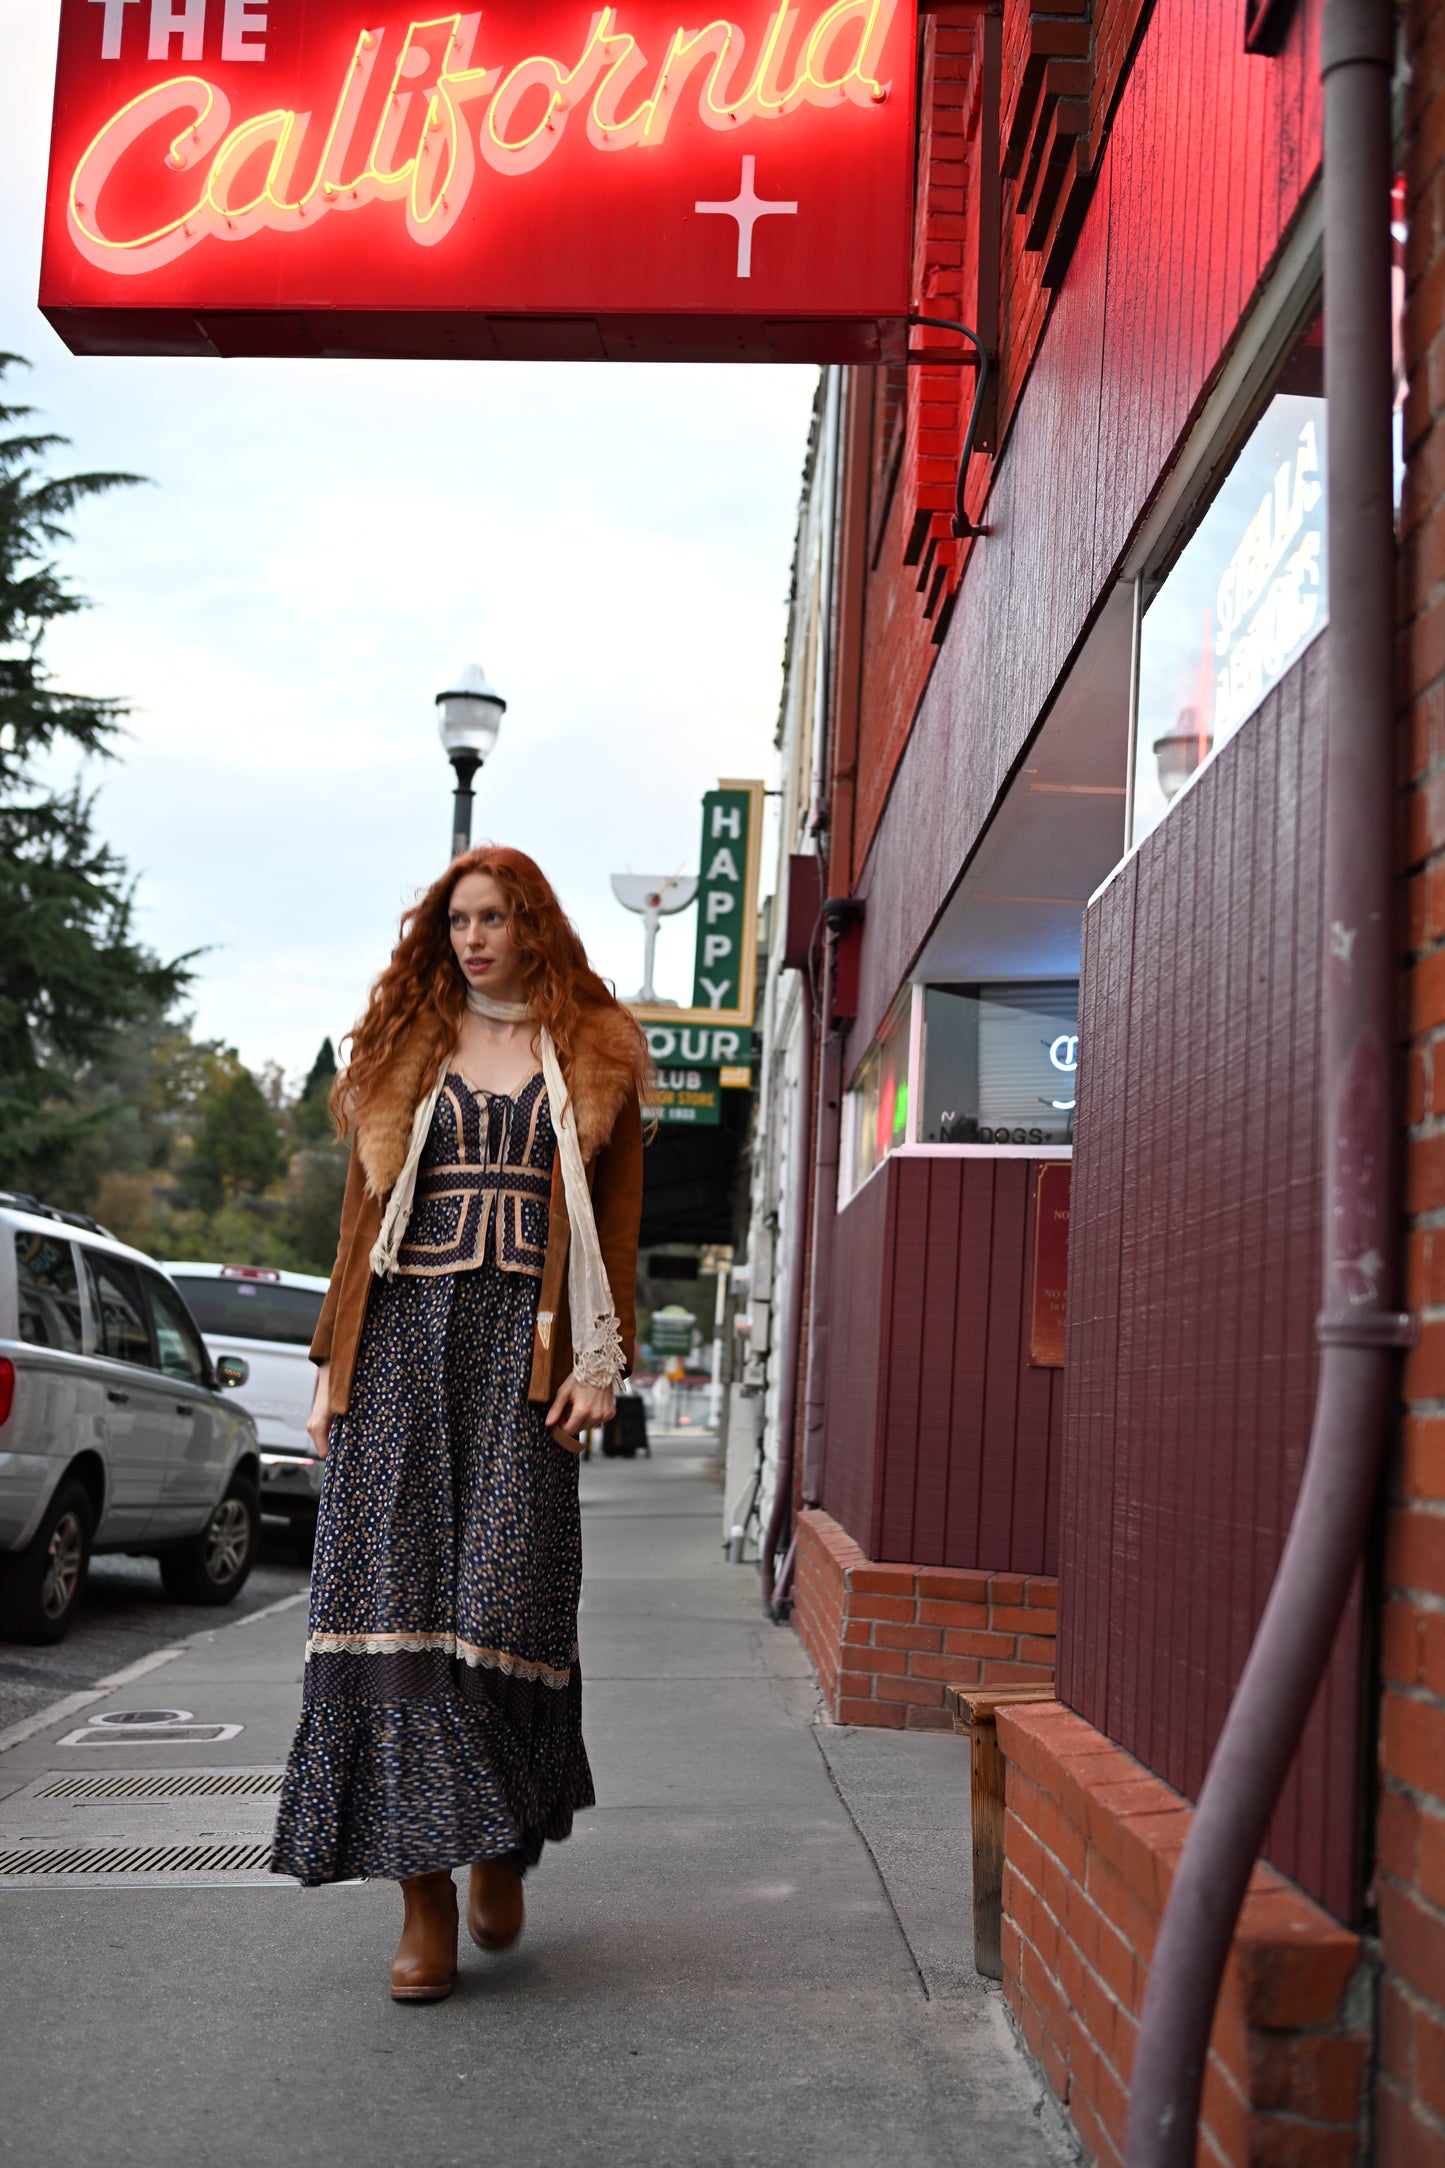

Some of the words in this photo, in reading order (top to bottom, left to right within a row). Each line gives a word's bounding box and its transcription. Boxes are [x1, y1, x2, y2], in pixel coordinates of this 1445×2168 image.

[87, 0, 268, 61] THE
[67, 0, 899, 275] California
[699, 805, 741, 1011] HAPPY
[647, 1027, 741, 1062] OUR
[979, 1127, 1042, 1145] DOGS
